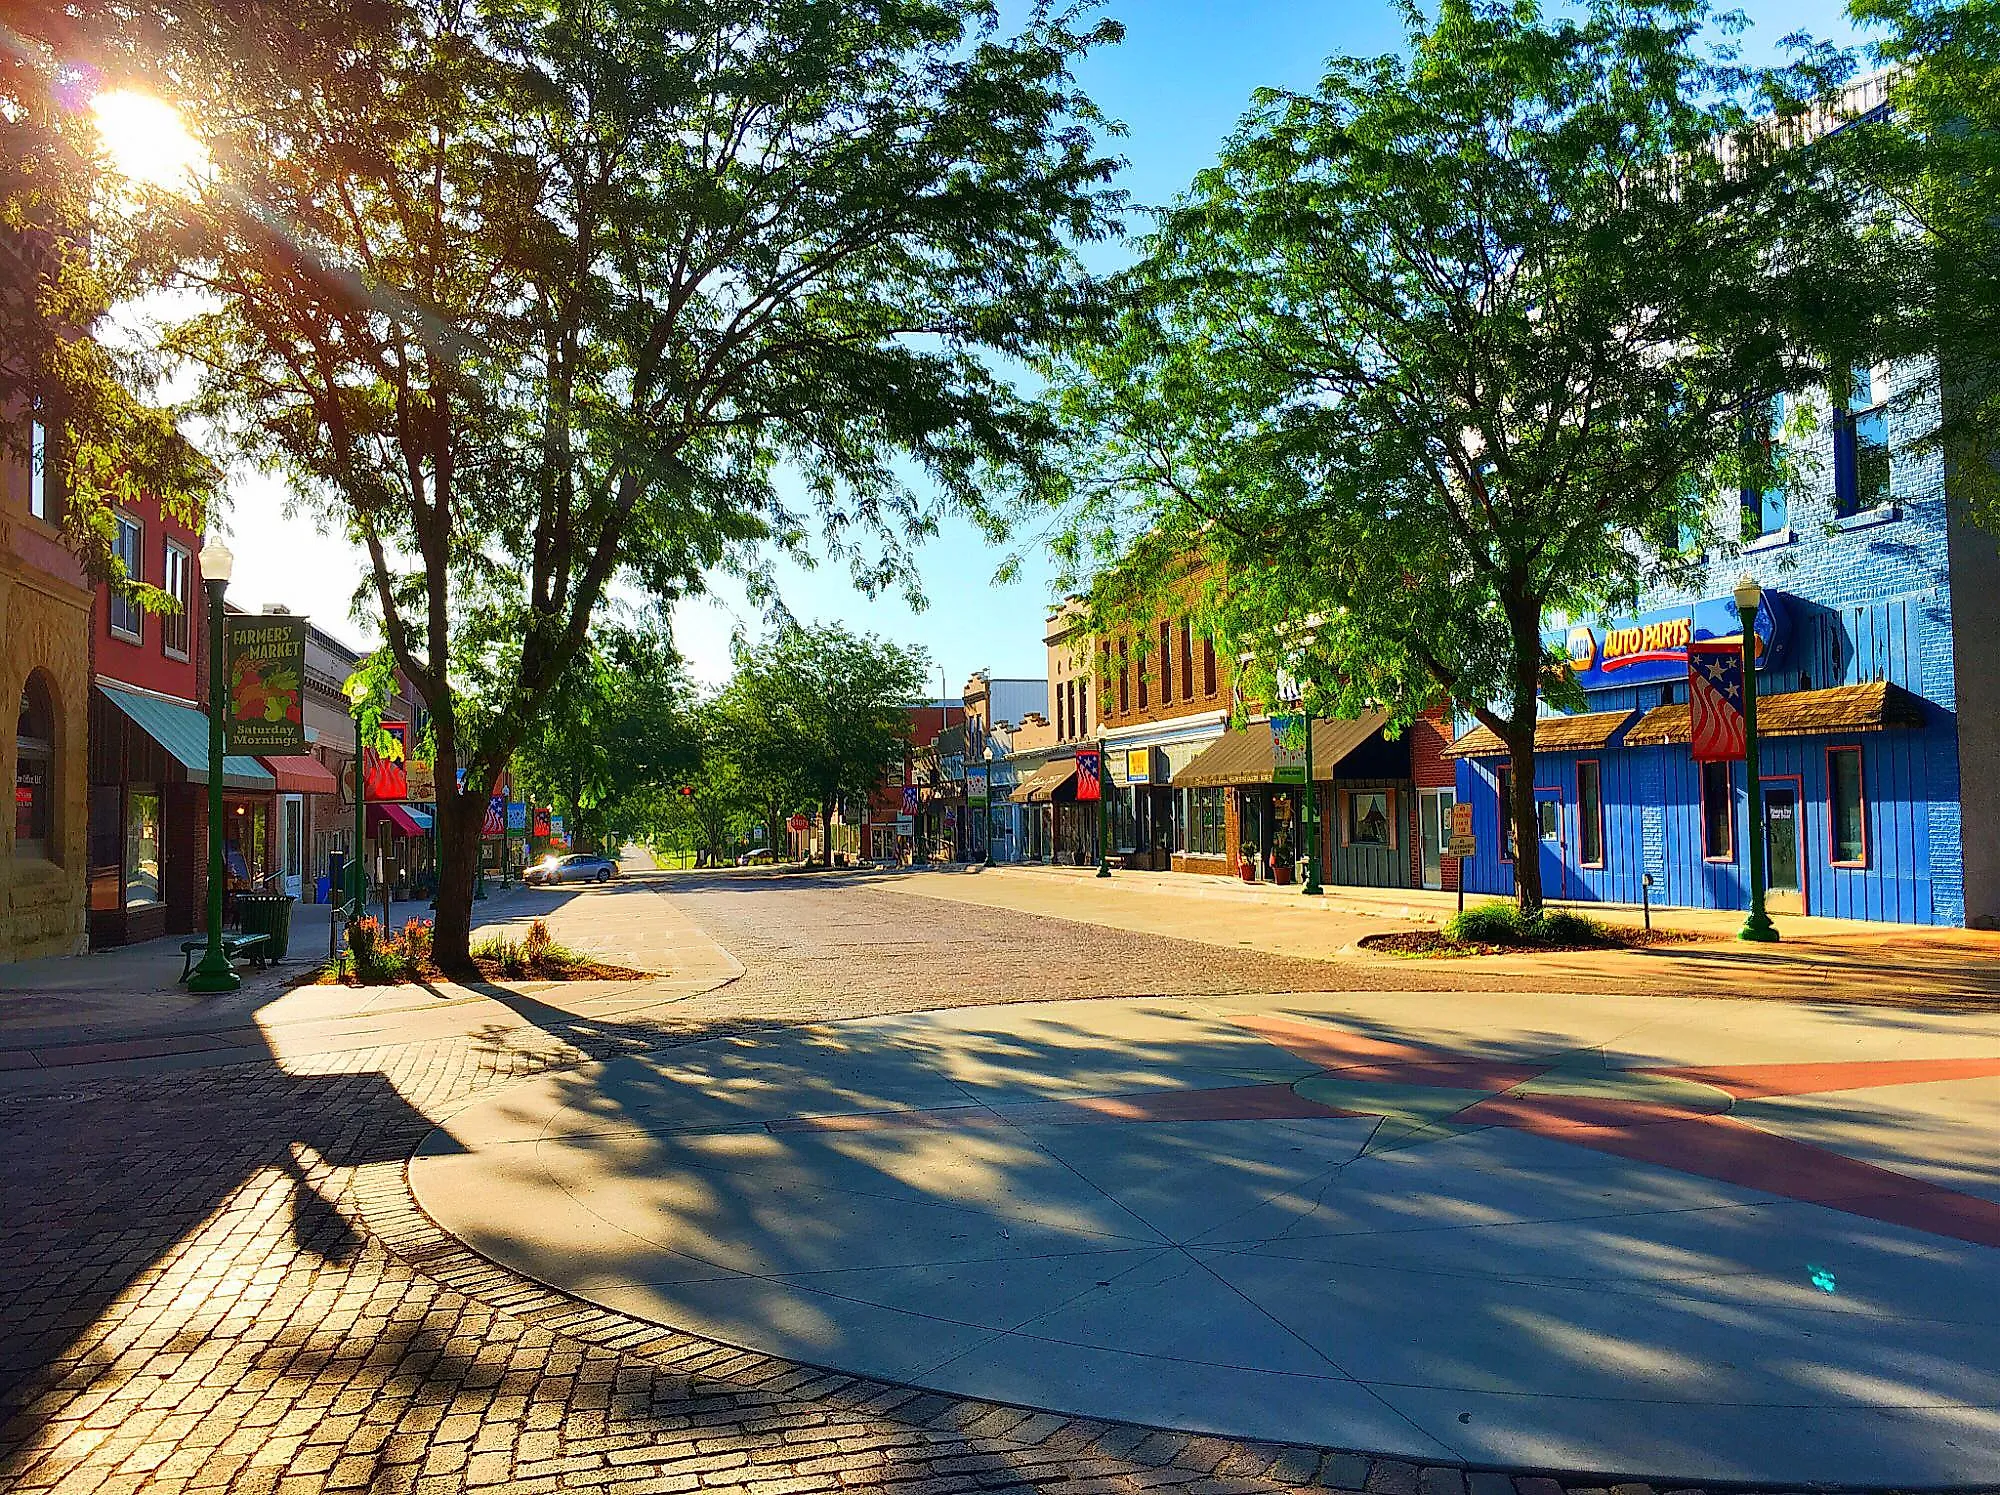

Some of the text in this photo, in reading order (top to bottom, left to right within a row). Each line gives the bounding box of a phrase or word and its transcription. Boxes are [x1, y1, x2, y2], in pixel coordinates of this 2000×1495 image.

[234, 627, 292, 645] FARMERS'
[1568, 618, 1692, 660] NAPA AUTO PARTS
[249, 641, 301, 660] MARKET
[237, 725, 295, 736] Saturday
[233, 736, 299, 747] Mornings
[792, 818, 806, 827] STOP
